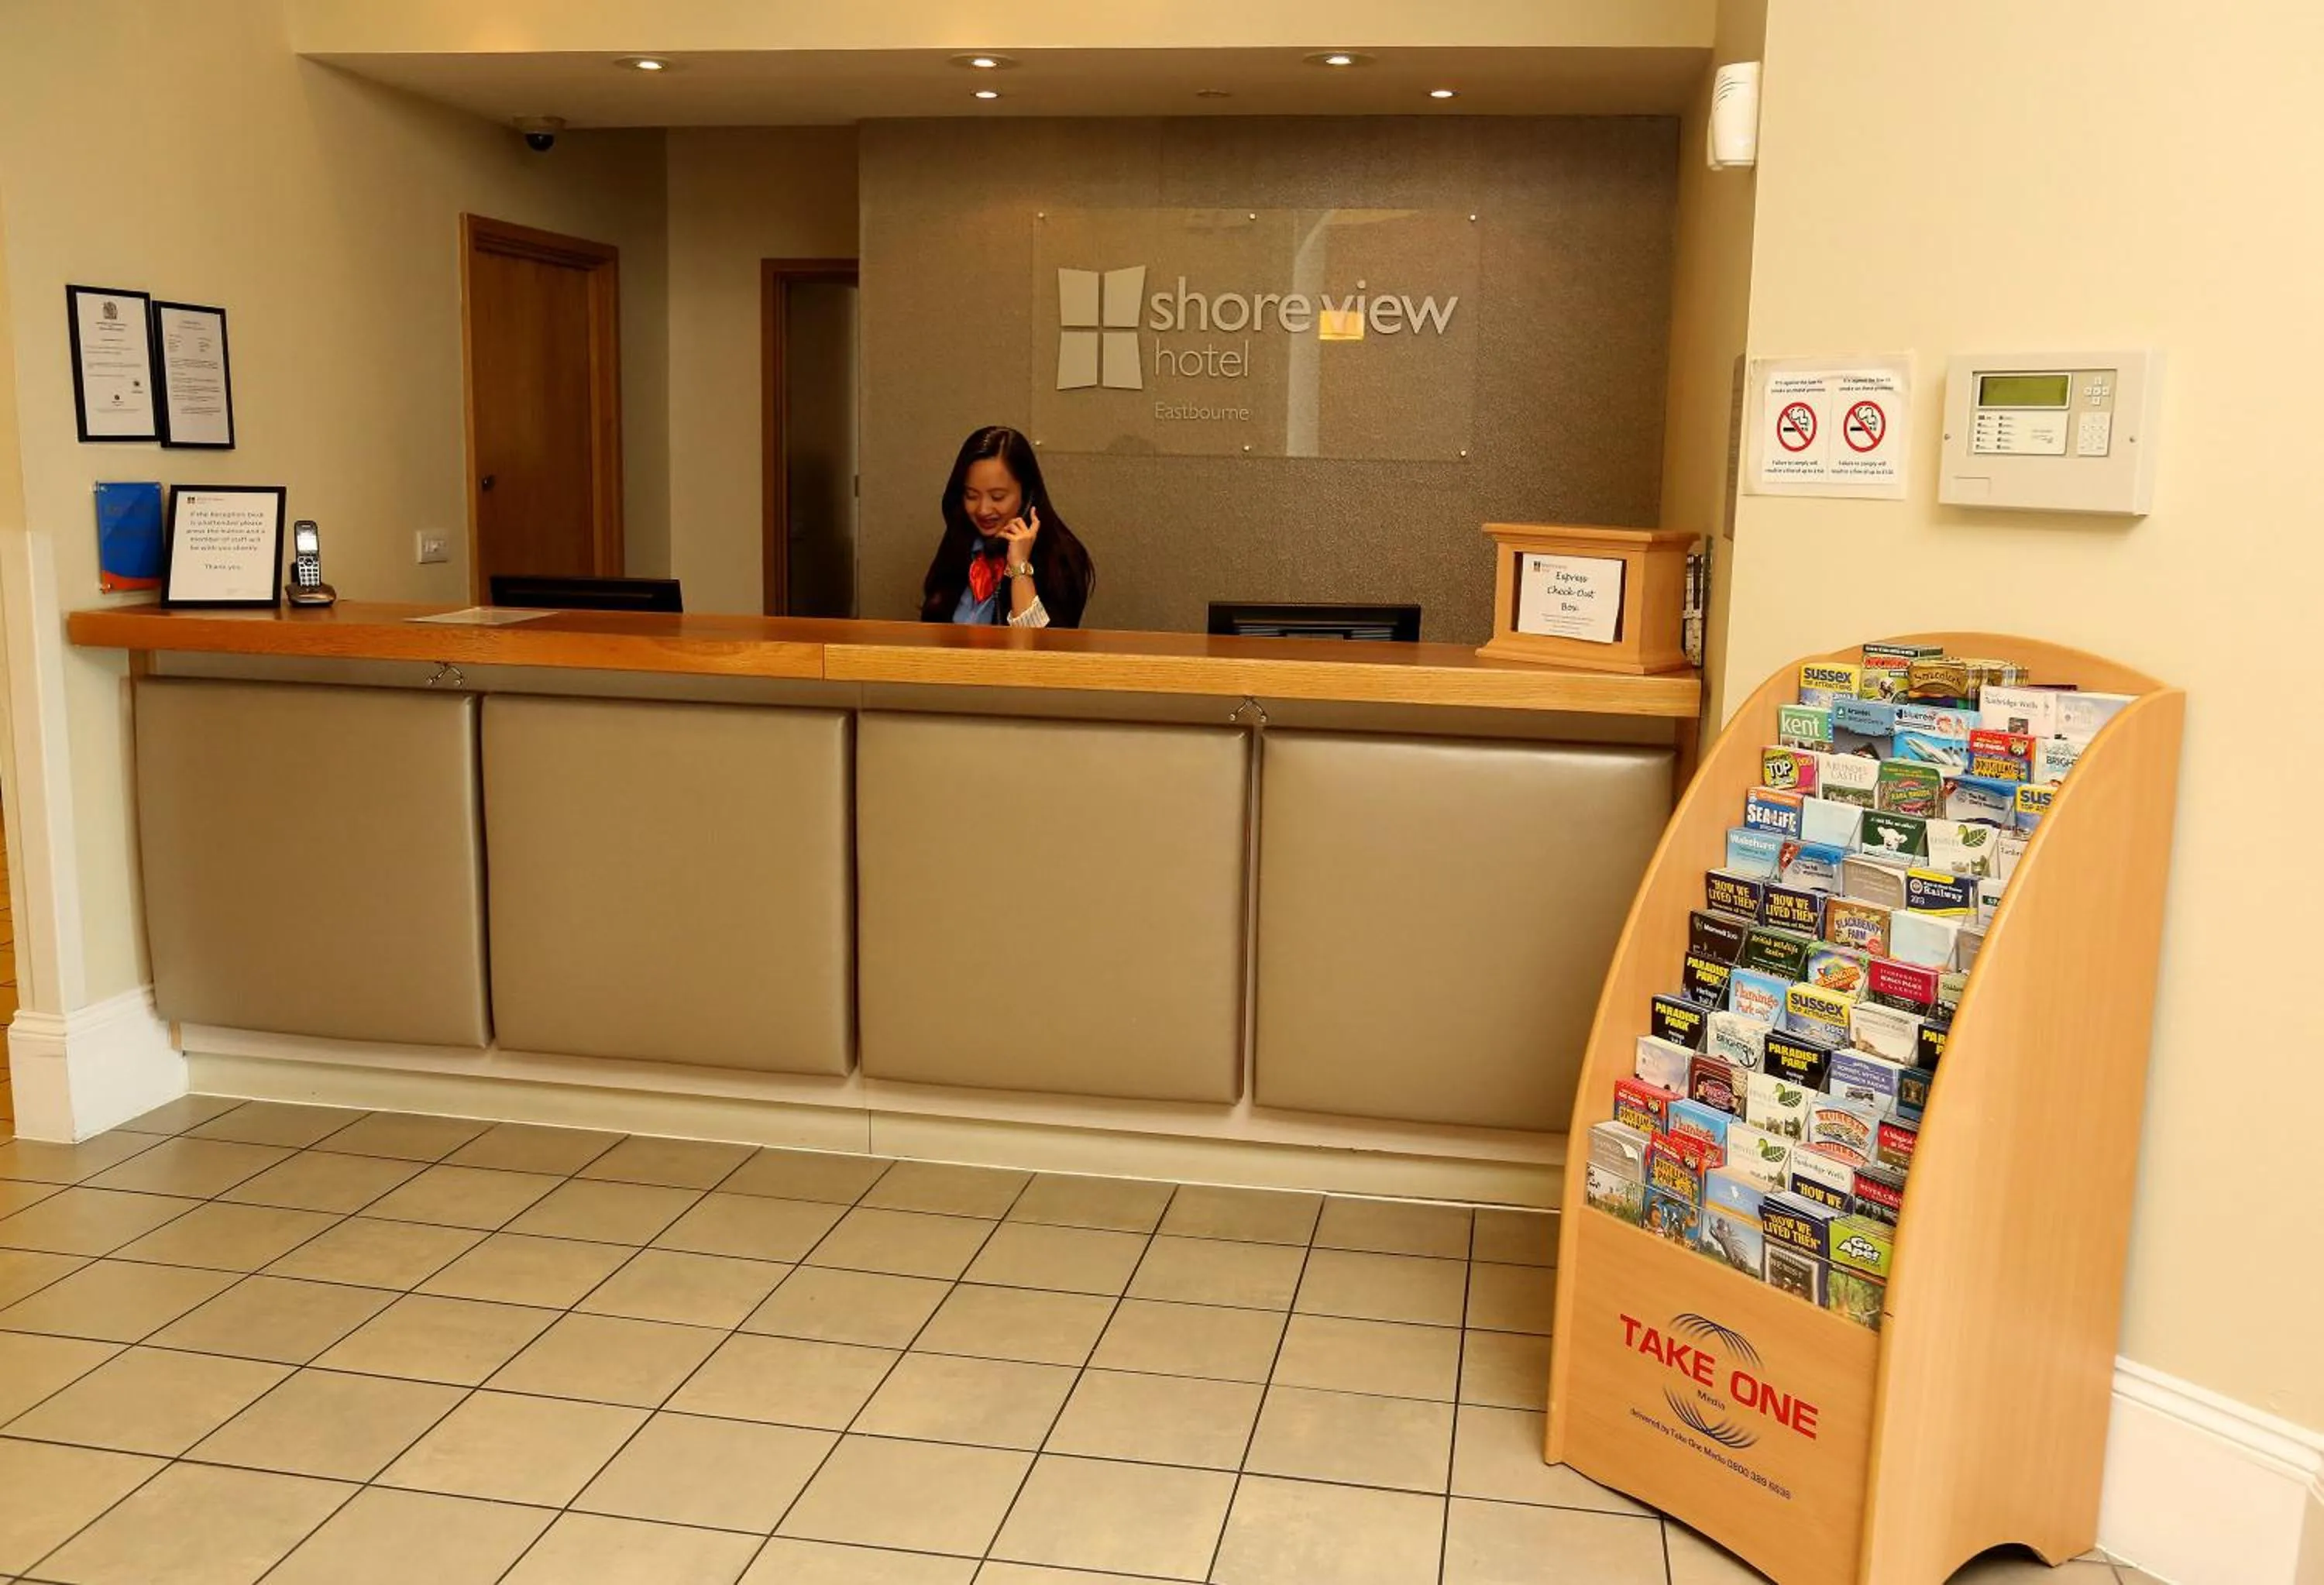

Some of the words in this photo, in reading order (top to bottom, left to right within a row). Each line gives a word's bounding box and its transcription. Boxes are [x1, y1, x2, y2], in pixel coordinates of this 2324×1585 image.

[1150, 276, 1312, 332] shore
[1318, 279, 1459, 335] view
[1153, 339, 1250, 377] hotel
[1153, 402, 1250, 421] Eastbourne
[1556, 571, 1588, 584] Express
[1803, 667, 1852, 683] sussex
[1781, 712, 1820, 737] kent
[1766, 760, 1792, 778] TOP
[2020, 789, 2052, 805] sus
[1747, 804, 1773, 824] SEA
[1708, 889, 1731, 903] LIVED
[1737, 885, 1750, 899] WE
[1923, 885, 1963, 903] Railway
[1765, 904, 1790, 918] LIVED
[1795, 897, 1810, 911] WE
[1834, 916, 1885, 936] BLACKBERRY
[1848, 928, 1867, 940] FARM
[1687, 957, 1729, 976] PARADISE
[1696, 970, 1721, 985] PARK
[1790, 992, 1843, 1016] sussex
[1655, 1002, 1700, 1025] PARADISE
[1666, 1017, 1690, 1031] PARK
[1768, 1042, 1819, 1064] PARADISE
[1781, 1057, 1808, 1071] PARK
[1827, 1193, 1842, 1209] WE
[1763, 1222, 1790, 1239] LIVED
[1796, 1220, 1812, 1237] WE
[1620, 1313, 1715, 1388] TAKE
[1730, 1370, 1818, 1440] ONE
[1697, 1389, 1726, 1411] Media
